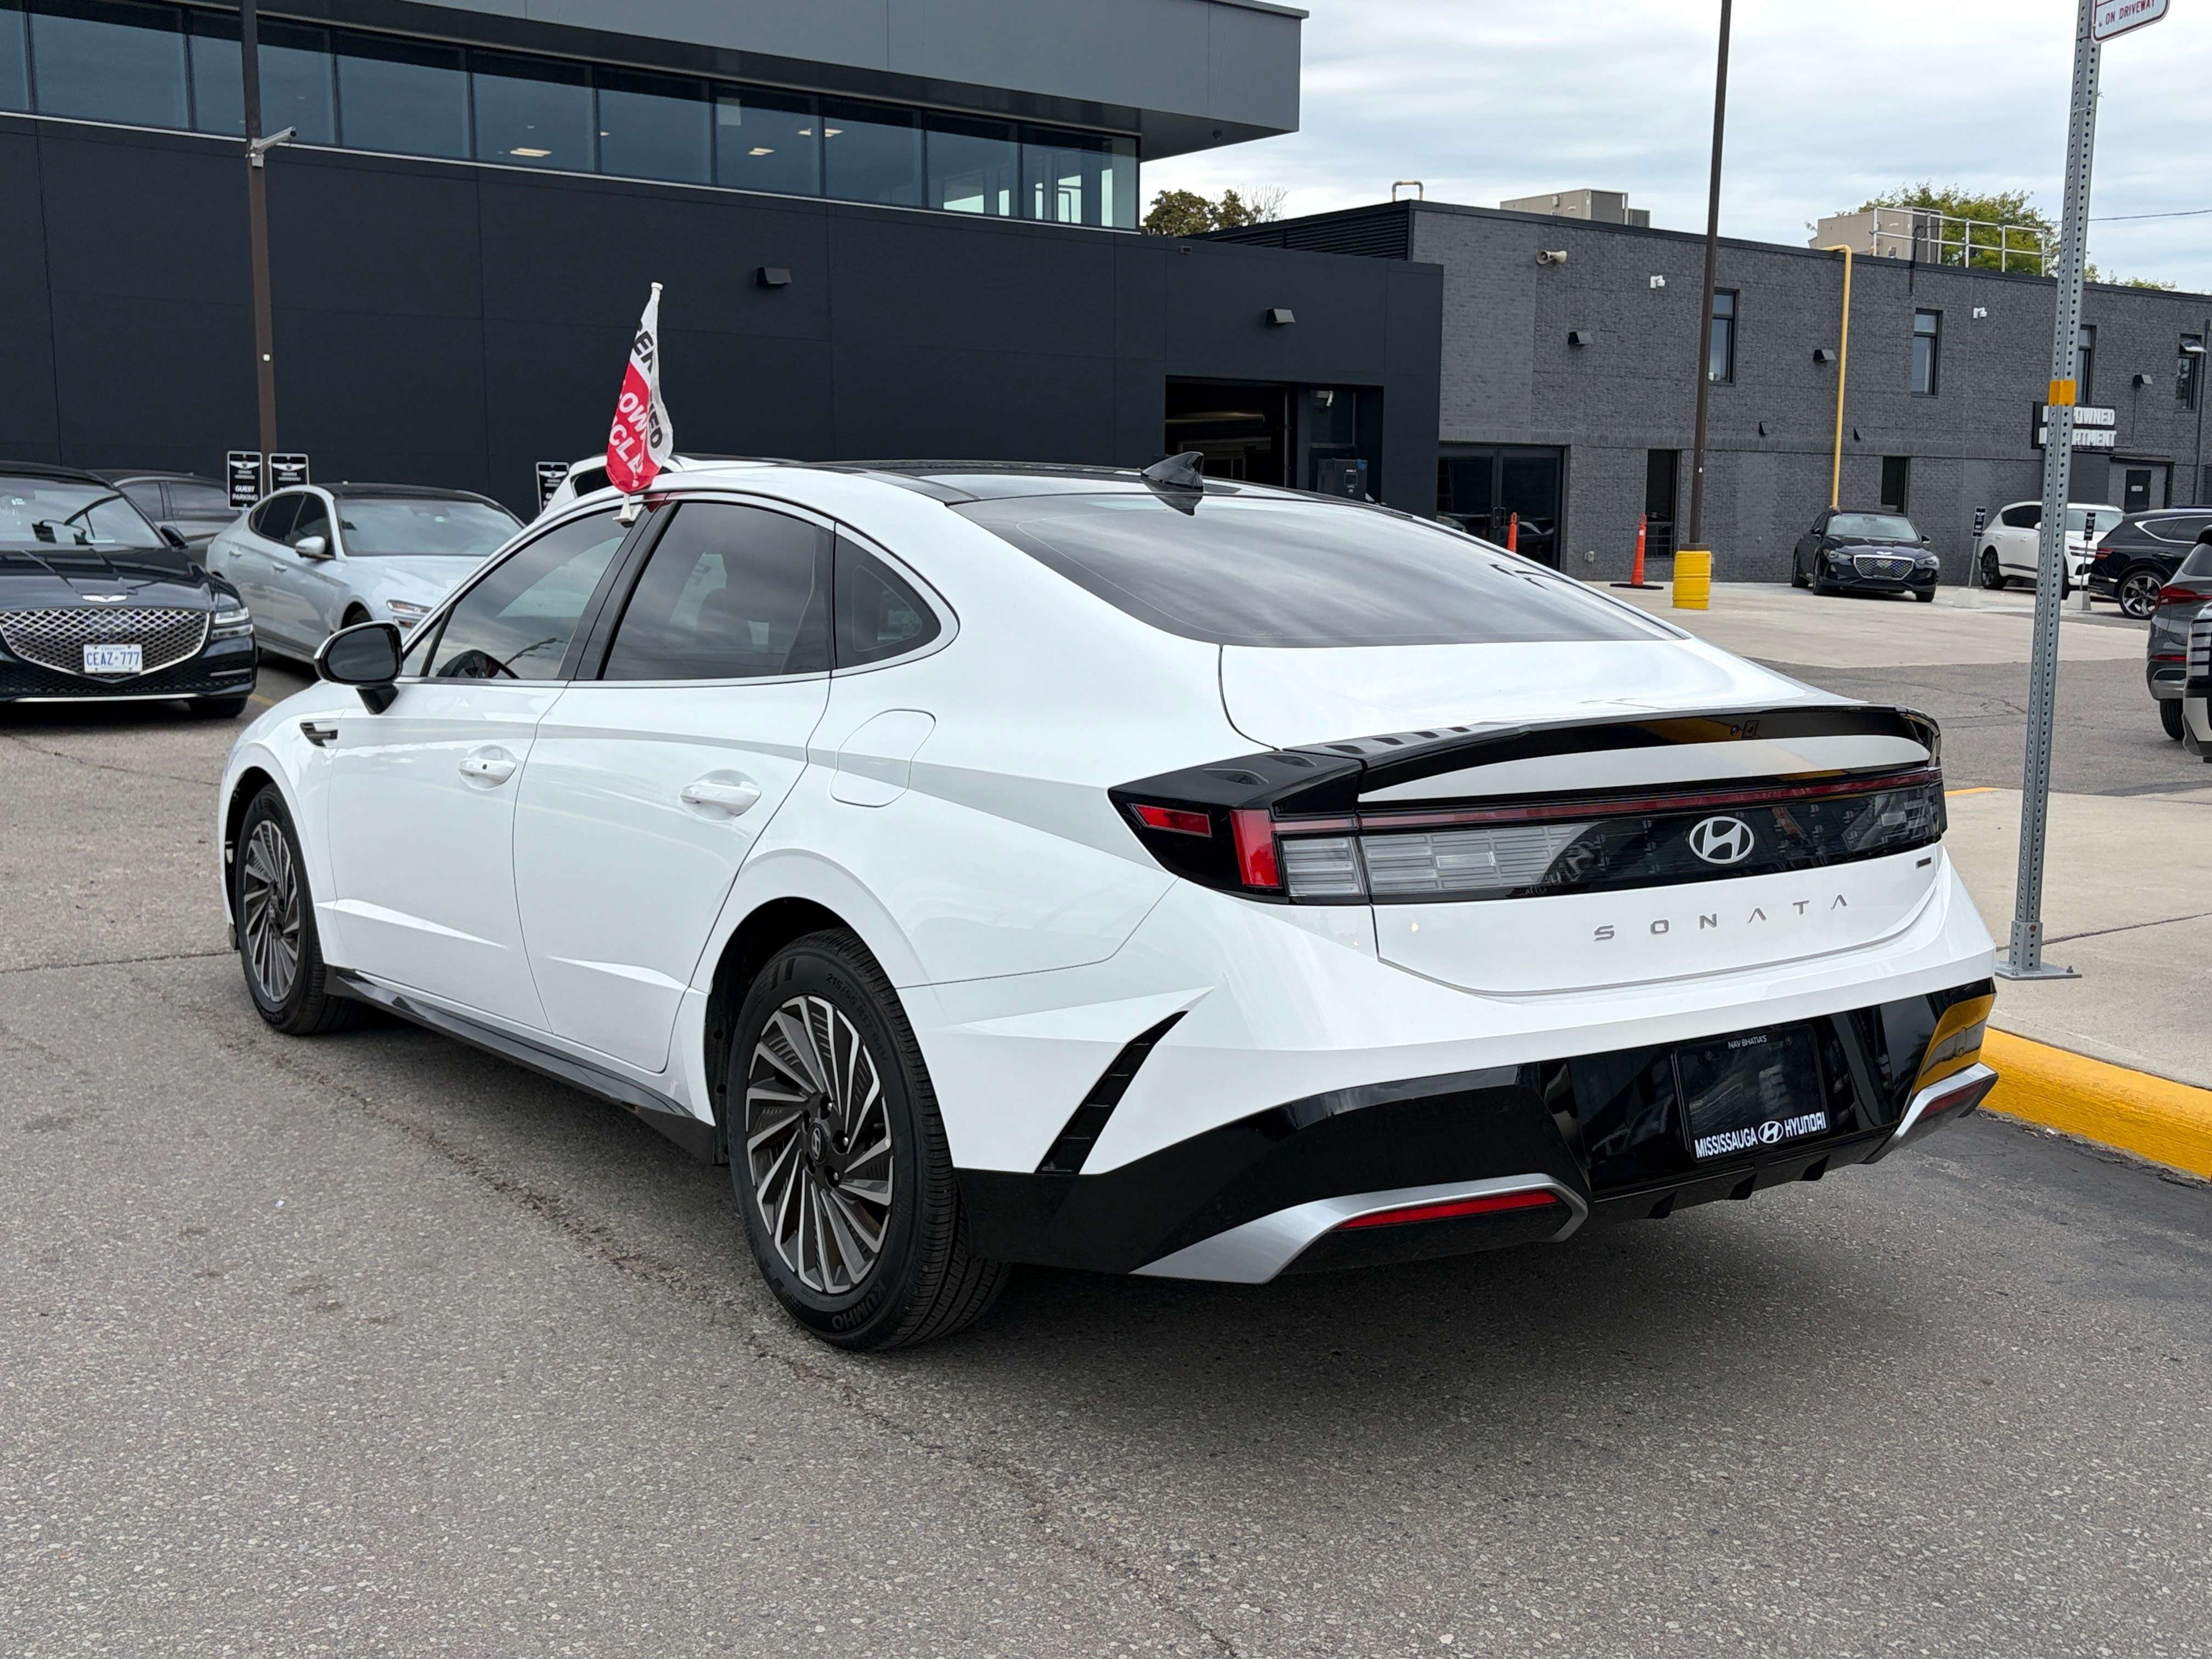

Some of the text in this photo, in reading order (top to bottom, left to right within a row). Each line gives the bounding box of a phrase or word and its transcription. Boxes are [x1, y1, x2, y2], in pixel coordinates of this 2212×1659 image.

[2106, 0, 2154, 25] ON DRIVEWAY
[87, 651, 140, 665] CEAZ 777
[1593, 894, 1848, 941] SONATA
[1728, 1040, 1741, 1049] NAV
[1694, 1111, 1827, 1159] MISSISSAUGA HYUNDAI
